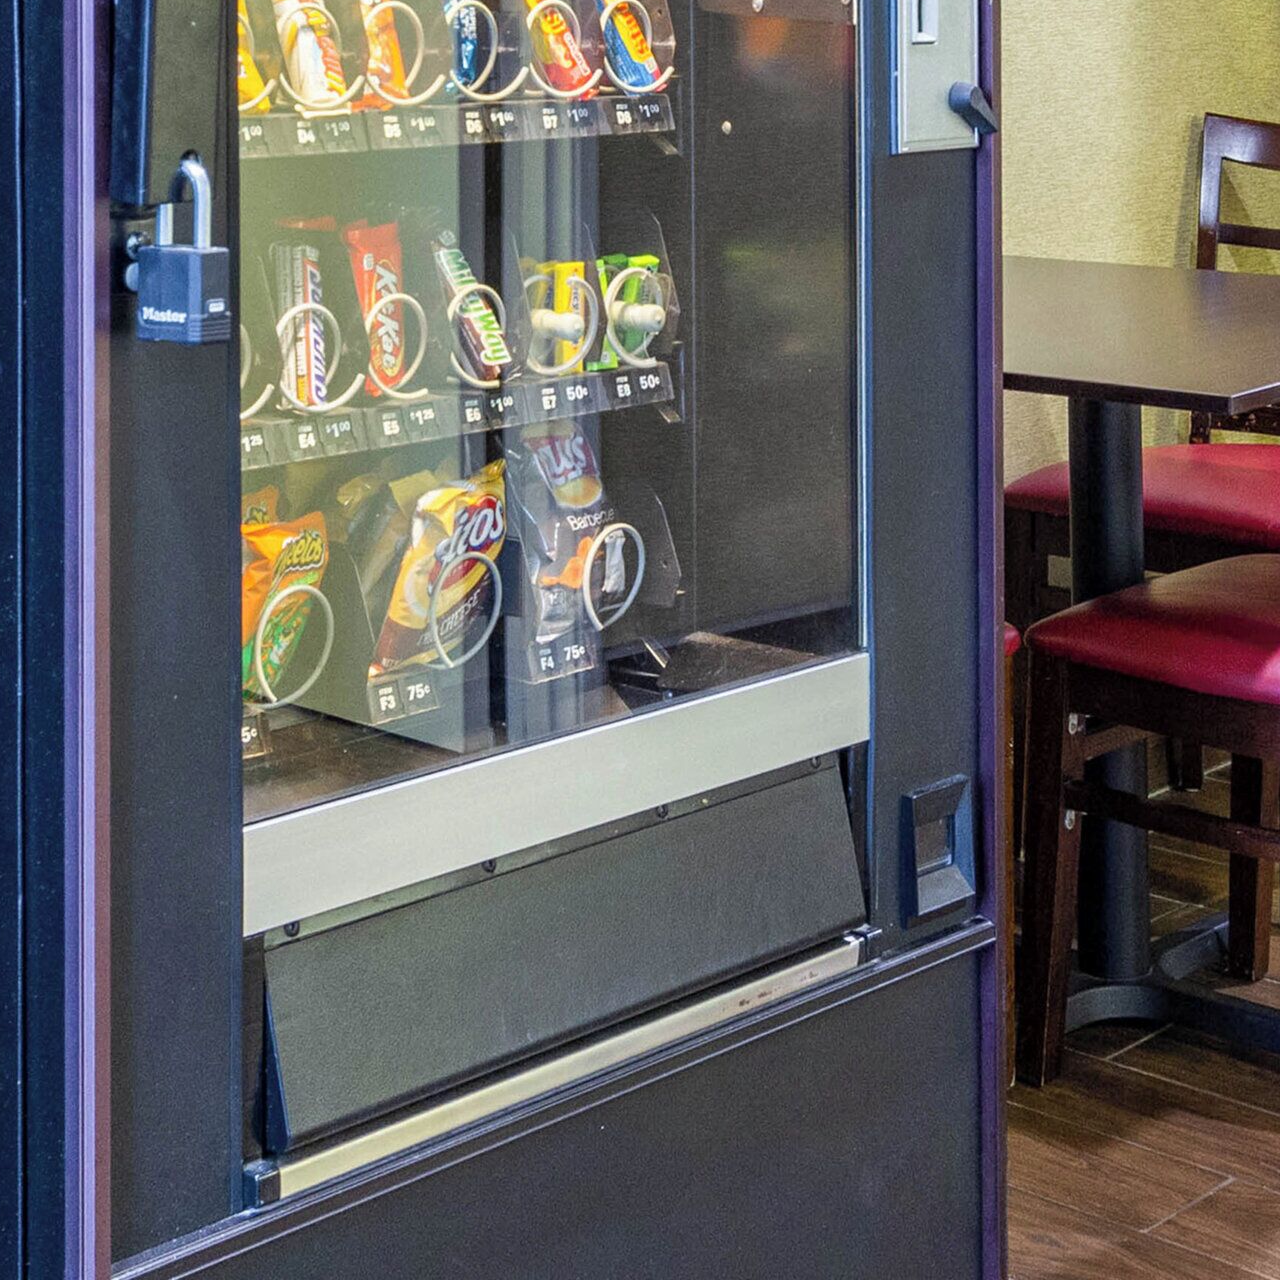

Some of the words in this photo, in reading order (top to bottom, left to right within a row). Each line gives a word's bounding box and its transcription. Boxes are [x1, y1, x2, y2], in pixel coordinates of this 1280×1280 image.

[542, 114, 558, 130] D7
[615, 110, 631, 125] D8
[141, 306, 188, 324] Master
[616, 383, 631, 398] E8
[639, 374, 660, 389] 50¢
[542, 395, 557, 410] E7
[565, 385, 588, 401] 50¢
[465, 408, 482, 422] E6
[298, 433, 316, 449] E4
[566, 508, 616, 532] Barbecue
[540, 655, 555, 671] F4
[563, 645, 586, 661] 75¢
[379, 695, 397, 712] F3
[406, 684, 431, 702] 75¢
[241, 726, 258, 743] 5¢
